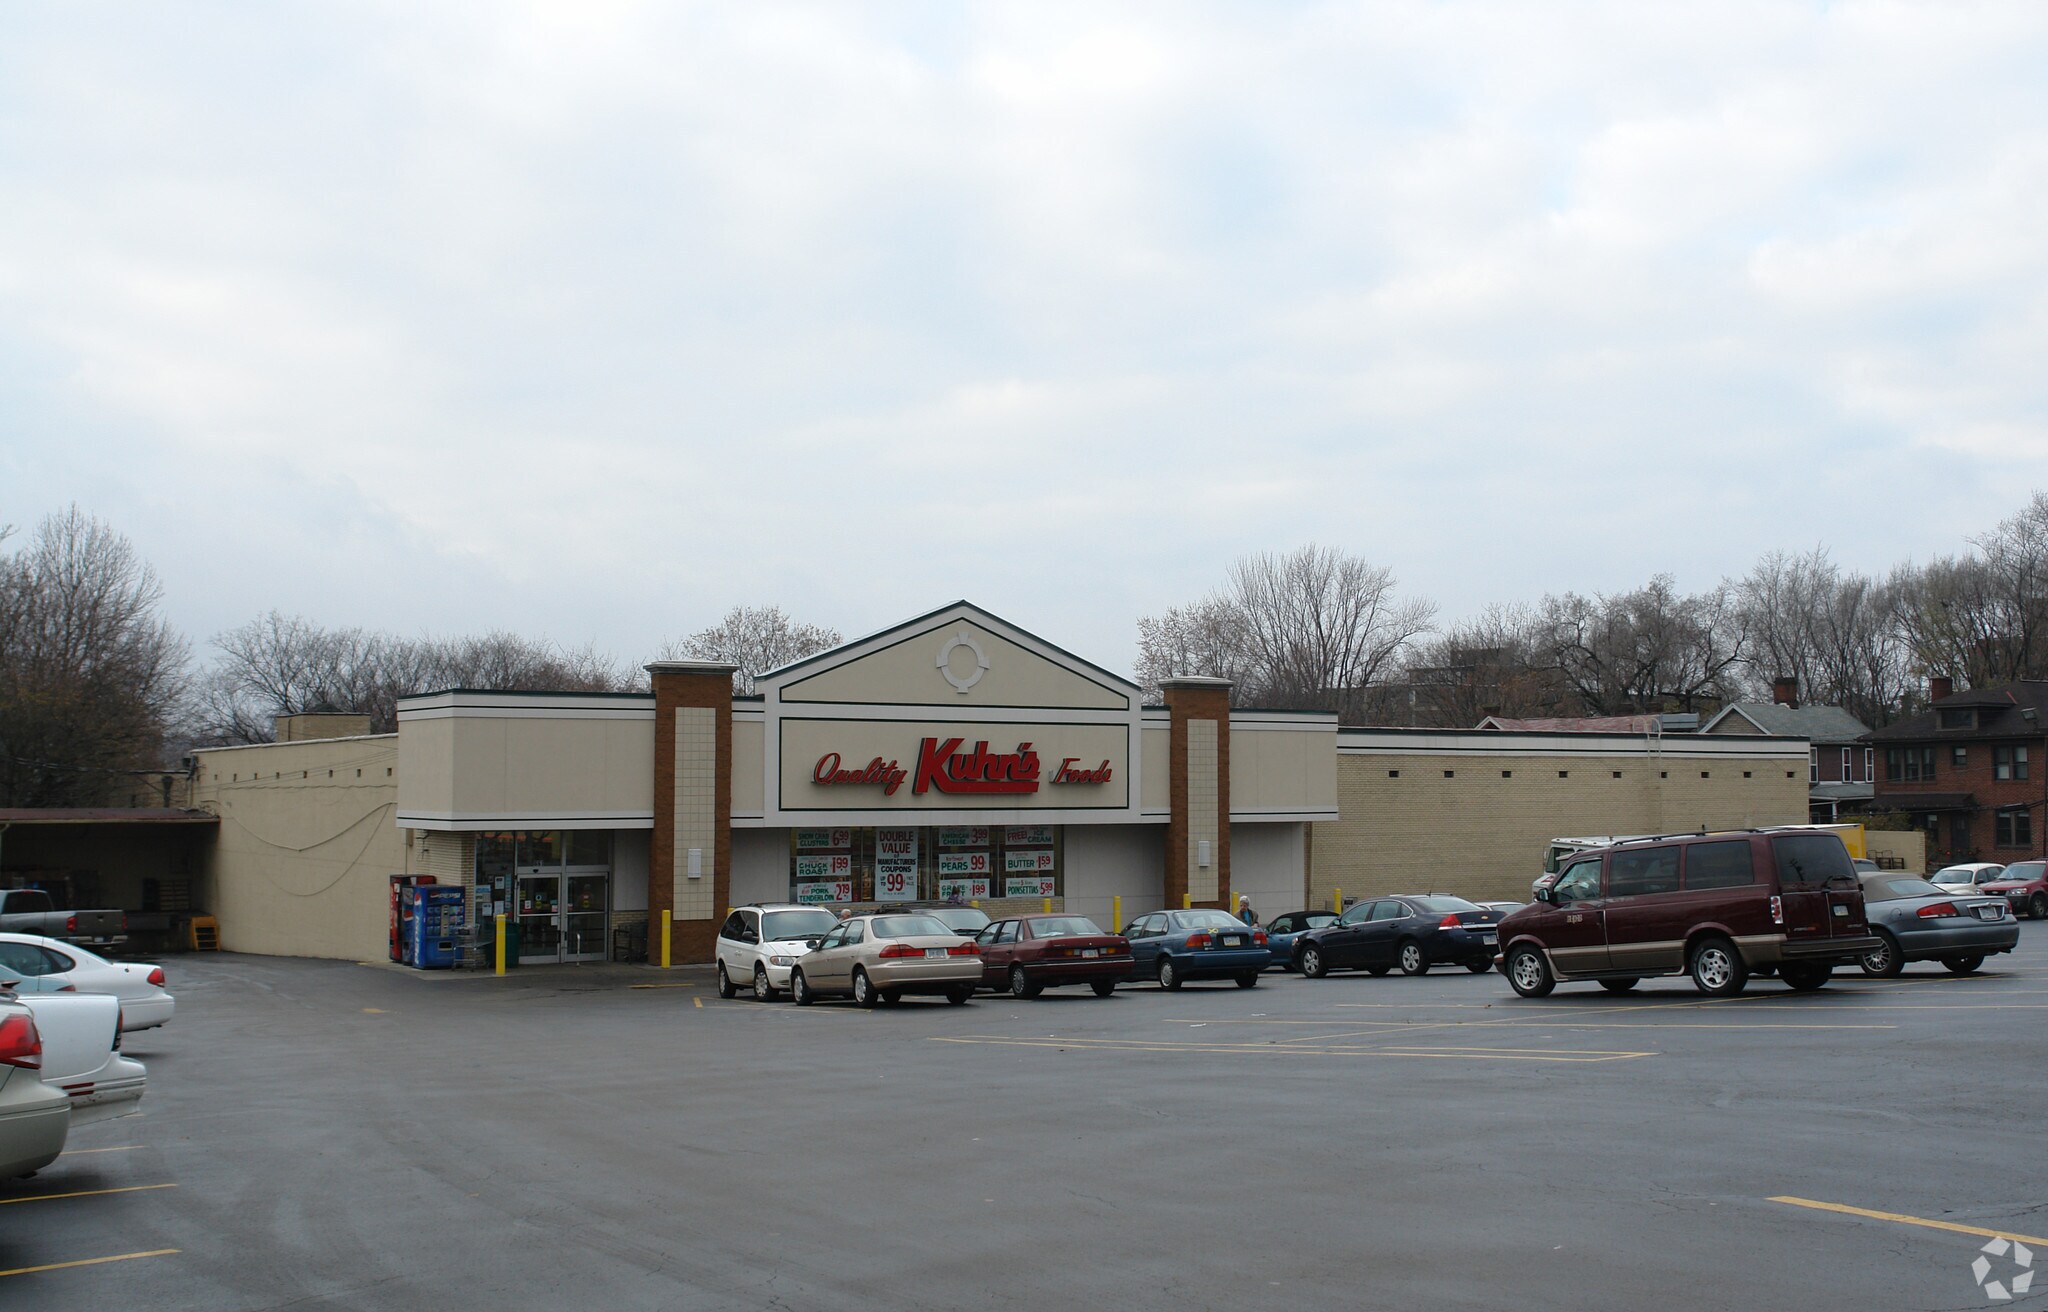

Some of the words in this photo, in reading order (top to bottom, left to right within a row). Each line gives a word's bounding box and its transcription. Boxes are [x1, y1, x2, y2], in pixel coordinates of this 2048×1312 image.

[813, 752, 908, 796] Quality
[912, 737, 1041, 794] Kuhn's
[1050, 757, 1113, 784] Foods
[879, 830, 914, 842] DOUBLE
[882, 842, 911, 854] VALUE
[880, 865, 912, 873] COUPONS
[941, 861, 969, 871] PEARS
[1007, 859, 1035, 869] BUTTER
